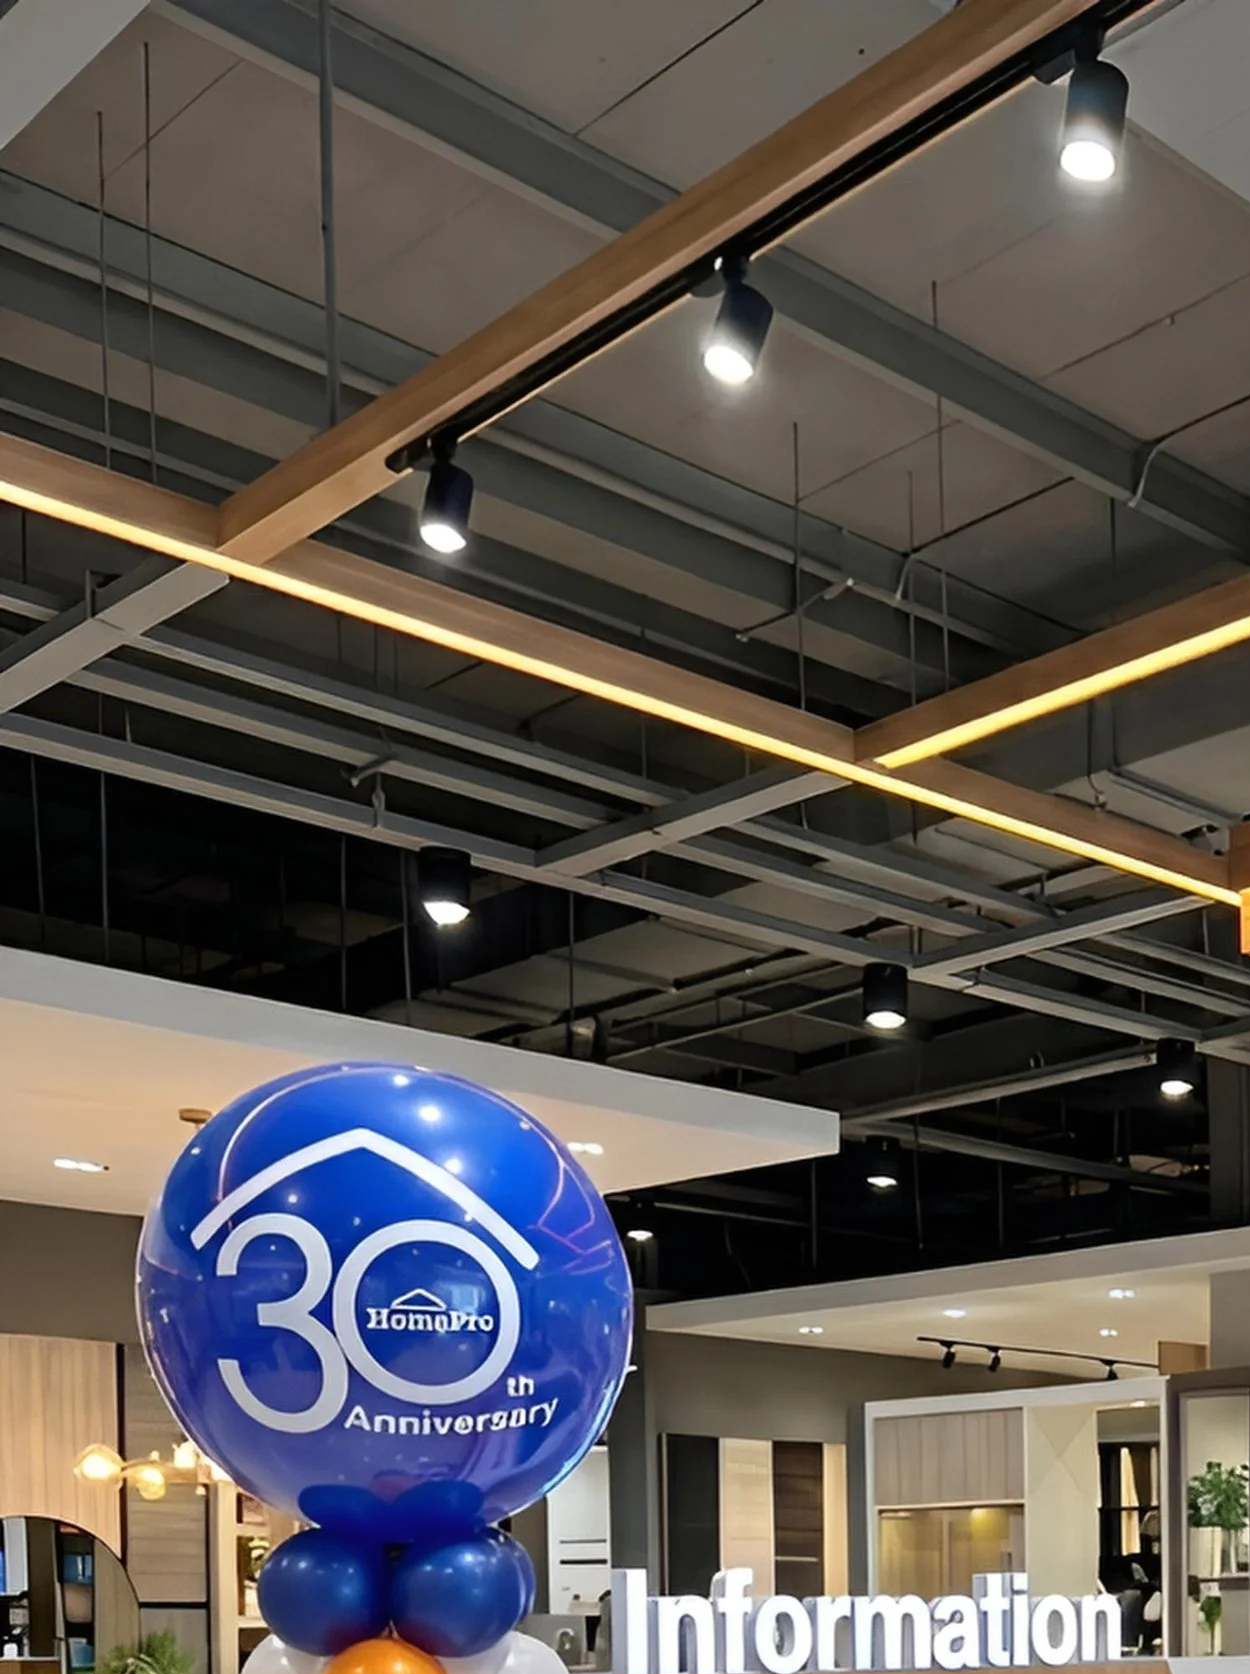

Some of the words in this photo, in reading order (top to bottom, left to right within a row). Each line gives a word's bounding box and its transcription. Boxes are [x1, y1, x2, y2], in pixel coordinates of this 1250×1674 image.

[216, 1213, 520, 1433] 30
[506, 1374, 535, 1397] th
[343, 1397, 559, 1435] Anniversary
